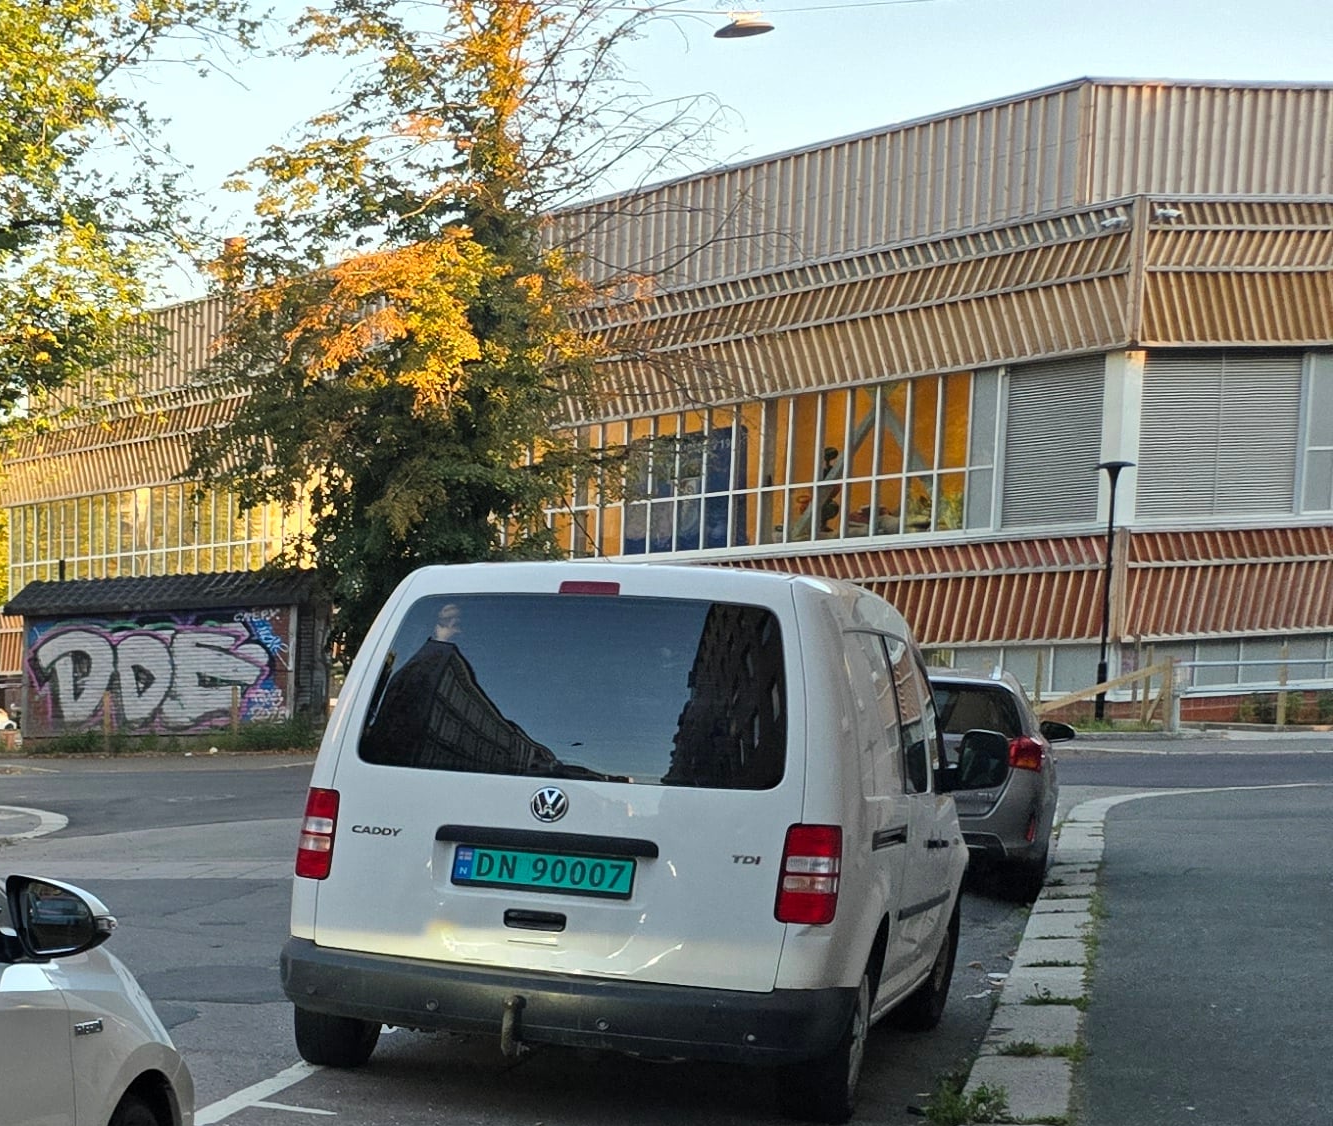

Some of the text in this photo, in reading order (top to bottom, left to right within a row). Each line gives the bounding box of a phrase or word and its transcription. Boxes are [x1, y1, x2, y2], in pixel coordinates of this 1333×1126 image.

[352, 825, 402, 836] CADDY
[732, 854, 761, 865] TDI
[476, 853, 517, 879] DN
[531, 858, 626, 888] 90007
